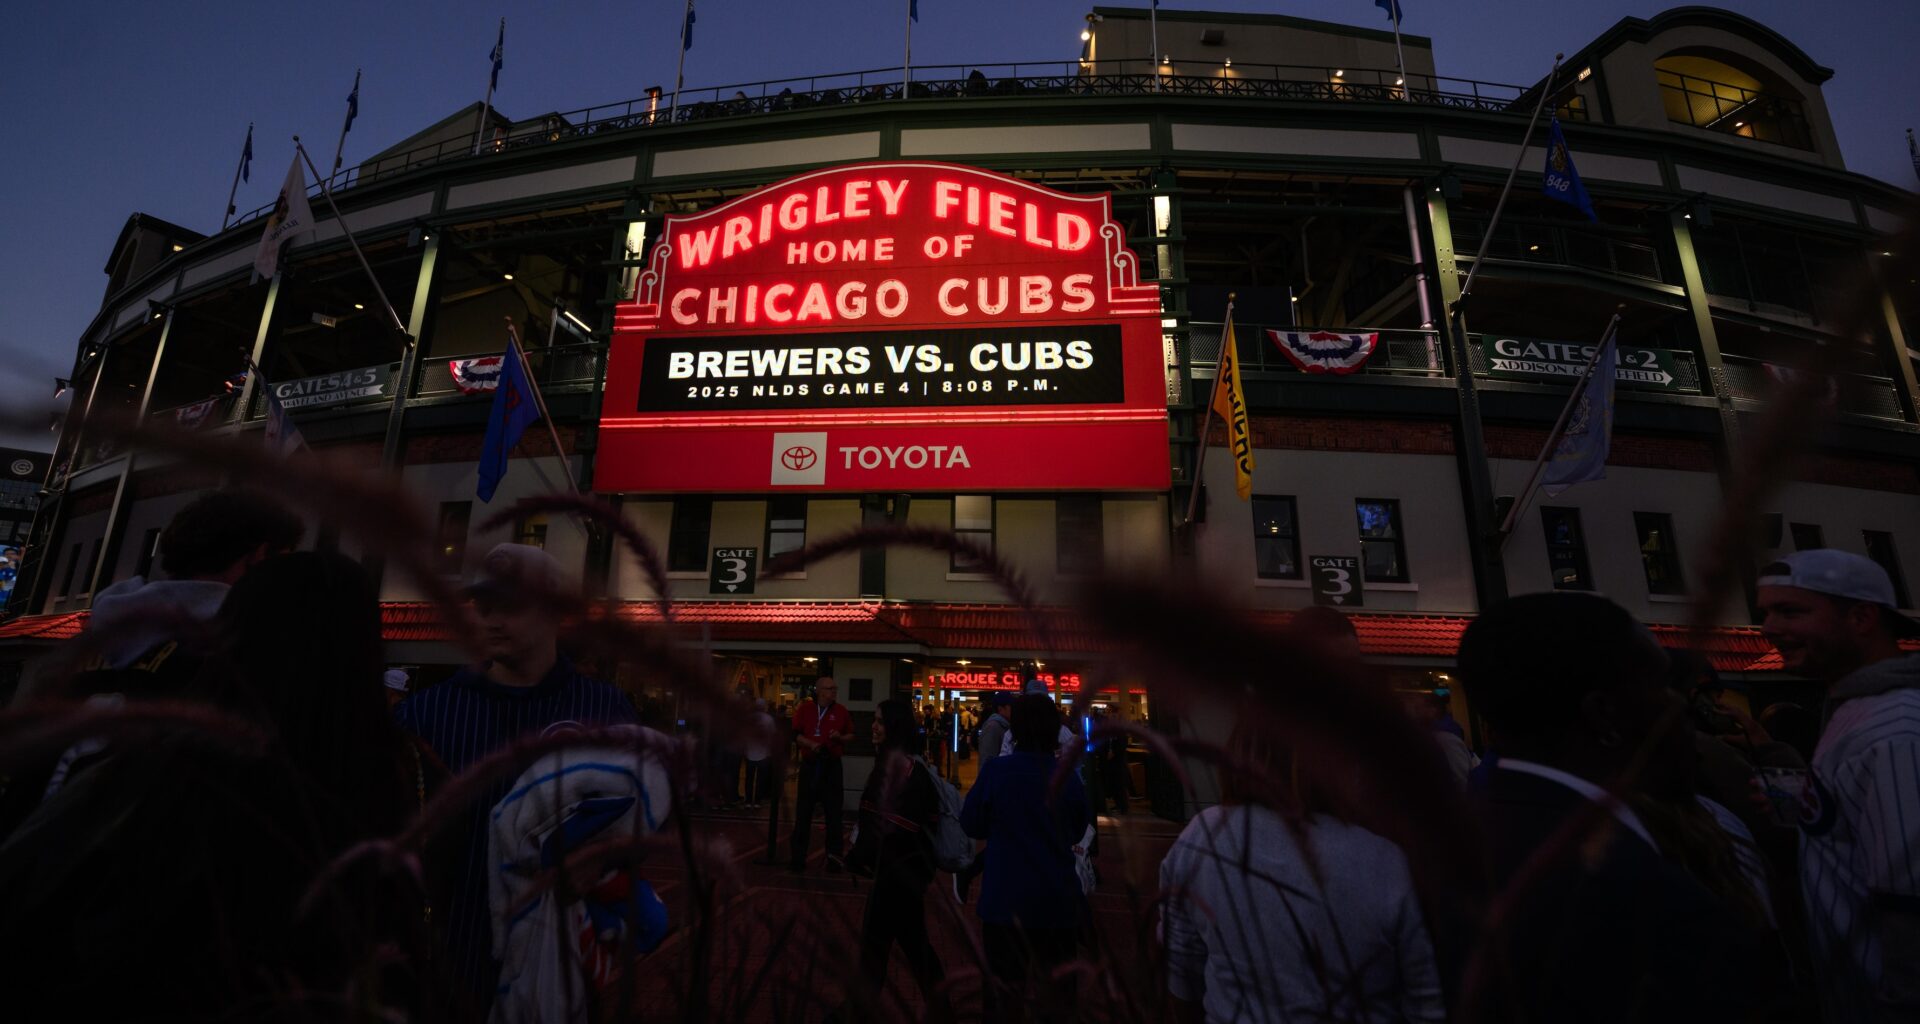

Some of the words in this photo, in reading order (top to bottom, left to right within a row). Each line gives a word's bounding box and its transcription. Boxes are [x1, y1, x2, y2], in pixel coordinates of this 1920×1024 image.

[1546, 174, 1571, 192] 848
[678, 179, 909, 269] WRIGLEY
[934, 180, 1092, 252] FIELD
[786, 237, 895, 265] HOME
[923, 234, 975, 259] OF
[670, 279, 908, 325] CHICAGO
[937, 273, 1096, 317] CUBS
[667, 346, 871, 379] BREWERS
[884, 344, 954, 373] VS.
[969, 340, 1095, 370] CUBS
[1494, 339, 1600, 364] GATES
[1625, 354, 1638, 364] &
[1637, 350, 1659, 368] 2
[1497, 361, 1566, 374] ADDISON
[276, 375, 341, 398] GATES
[362, 368, 377, 385] 5
[687, 385, 740, 398] 2025
[752, 384, 809, 397] NLDS
[822, 382, 885, 395] GAME
[898, 381, 909, 394] 4
[942, 380, 993, 393] 8:08
[1007, 378, 1059, 391] P.M.
[839, 446, 971, 469] TOYOTA
[716, 549, 754, 558] GATE
[1313, 558, 1357, 568] GATE
[718, 558, 748, 584] 3
[1320, 567, 1352, 595] 3
